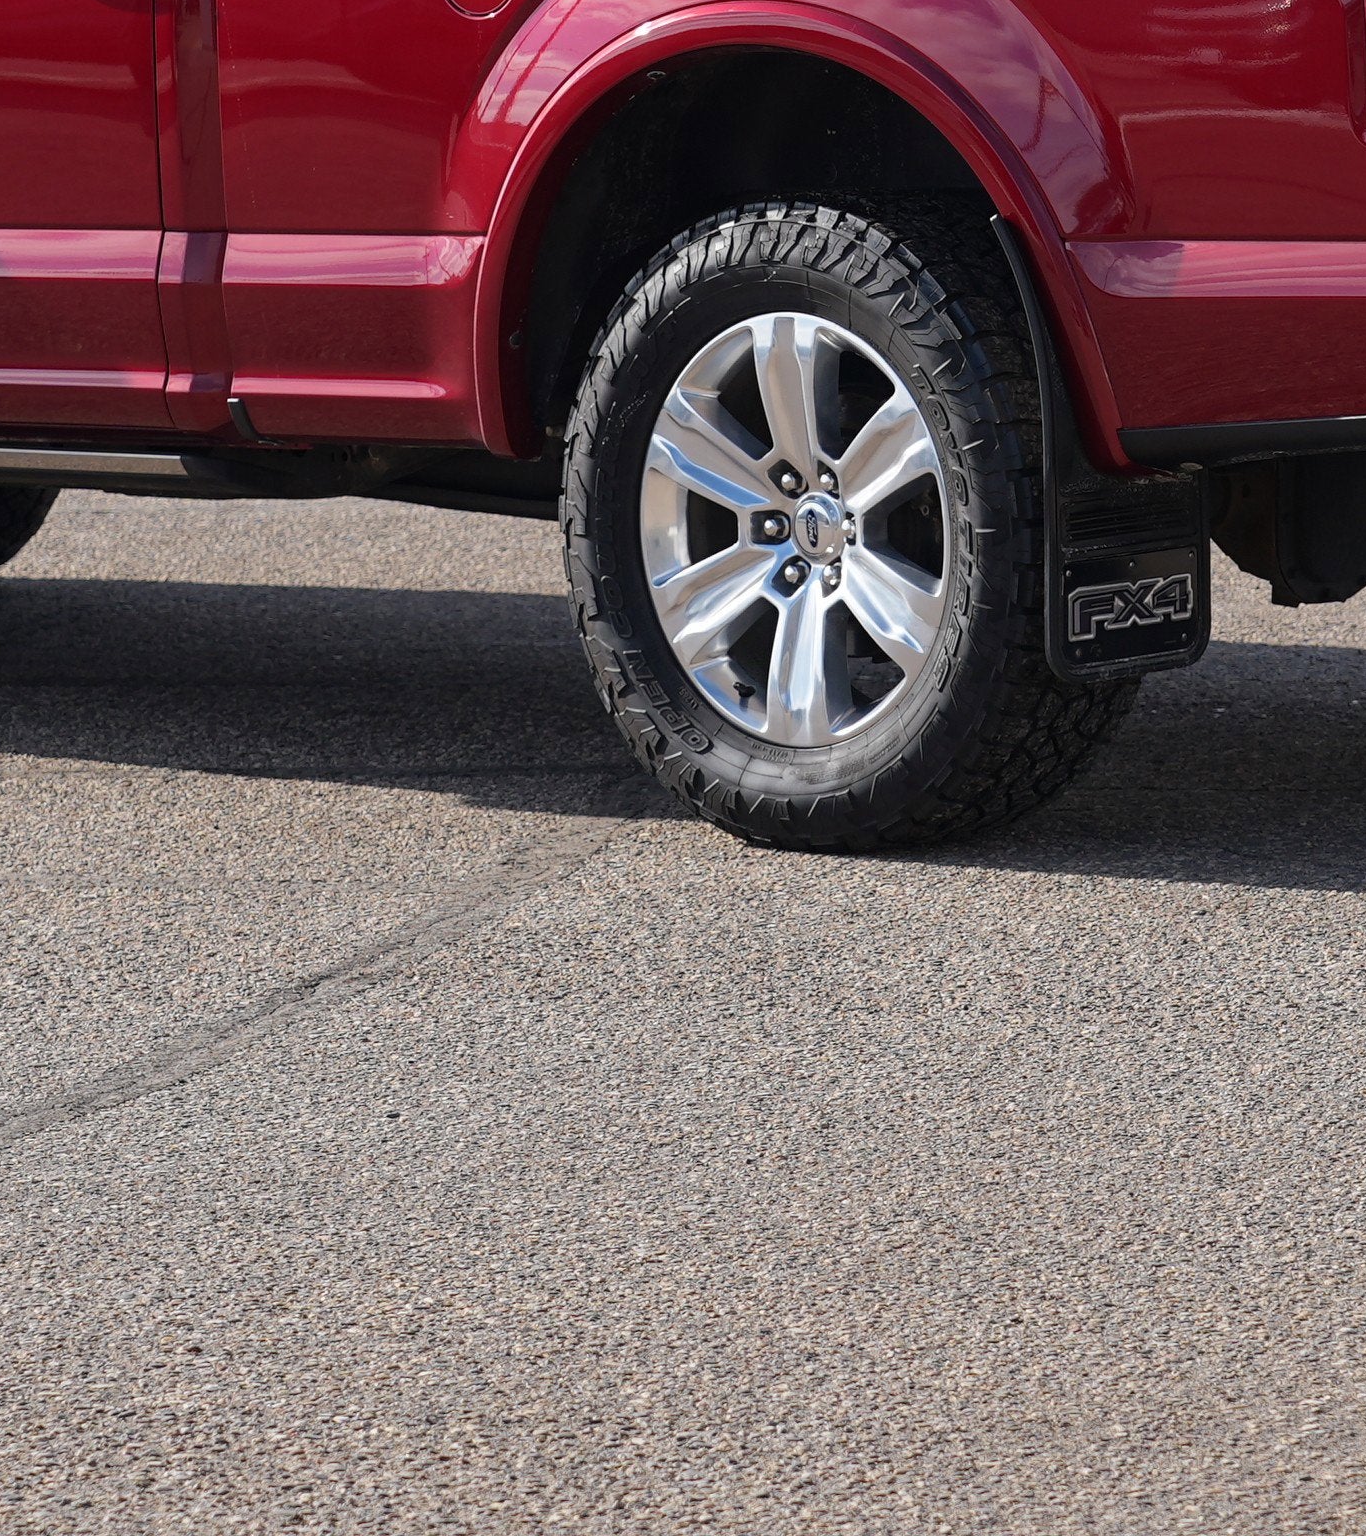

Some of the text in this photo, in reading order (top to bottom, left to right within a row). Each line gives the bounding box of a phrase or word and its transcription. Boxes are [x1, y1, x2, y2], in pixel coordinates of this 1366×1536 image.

[909, 361, 969, 508] TOYO
[934, 518, 971, 694] TIRES
[1068, 573, 1193, 642] FX4
[622, 646, 711, 755] OPEN
